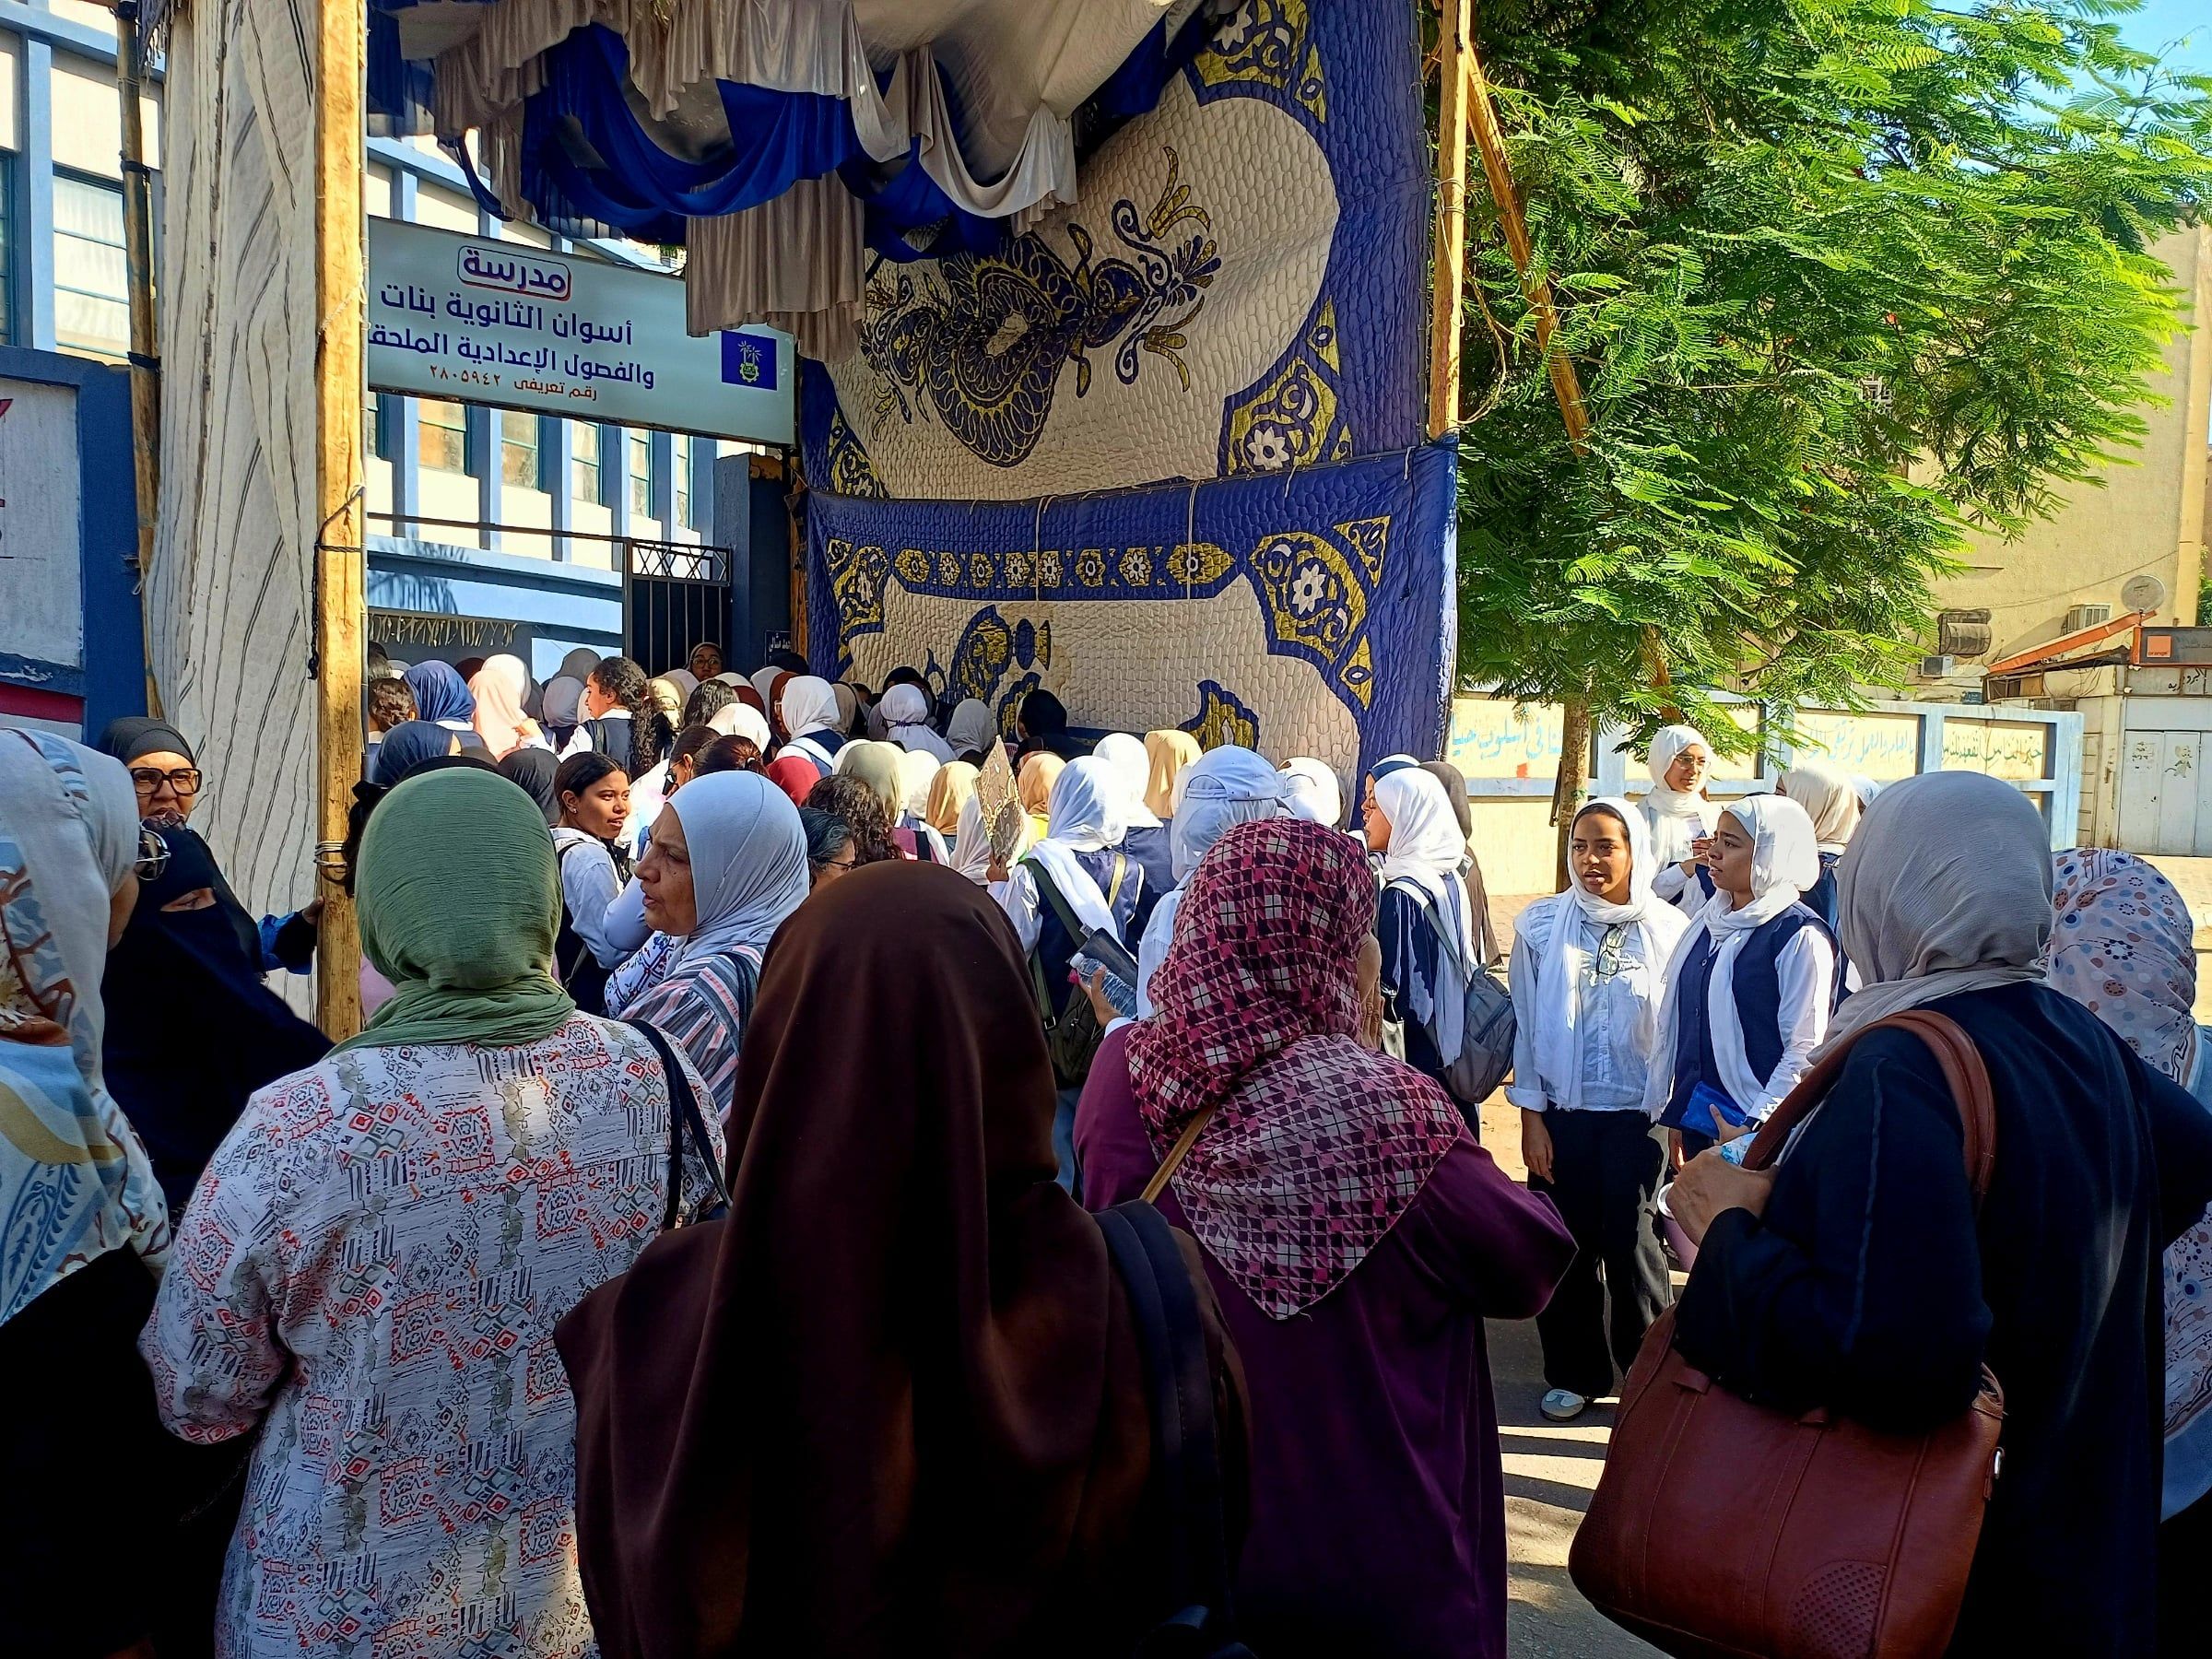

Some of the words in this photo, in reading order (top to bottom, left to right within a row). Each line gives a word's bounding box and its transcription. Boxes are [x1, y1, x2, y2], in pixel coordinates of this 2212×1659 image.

[464, 250, 566, 292] مدرسة
[381, 284, 435, 319] بنات
[446, 291, 542, 332] الثانوية
[369, 324, 448, 355] الملحق
[553, 312, 631, 345] أسوان
[457, 335, 556, 374] الإعدادية
[564, 354, 654, 389] والفصول
[429, 365, 500, 386] ٢٨٠٥٩٤٢
[569, 385, 597, 401] رقم
